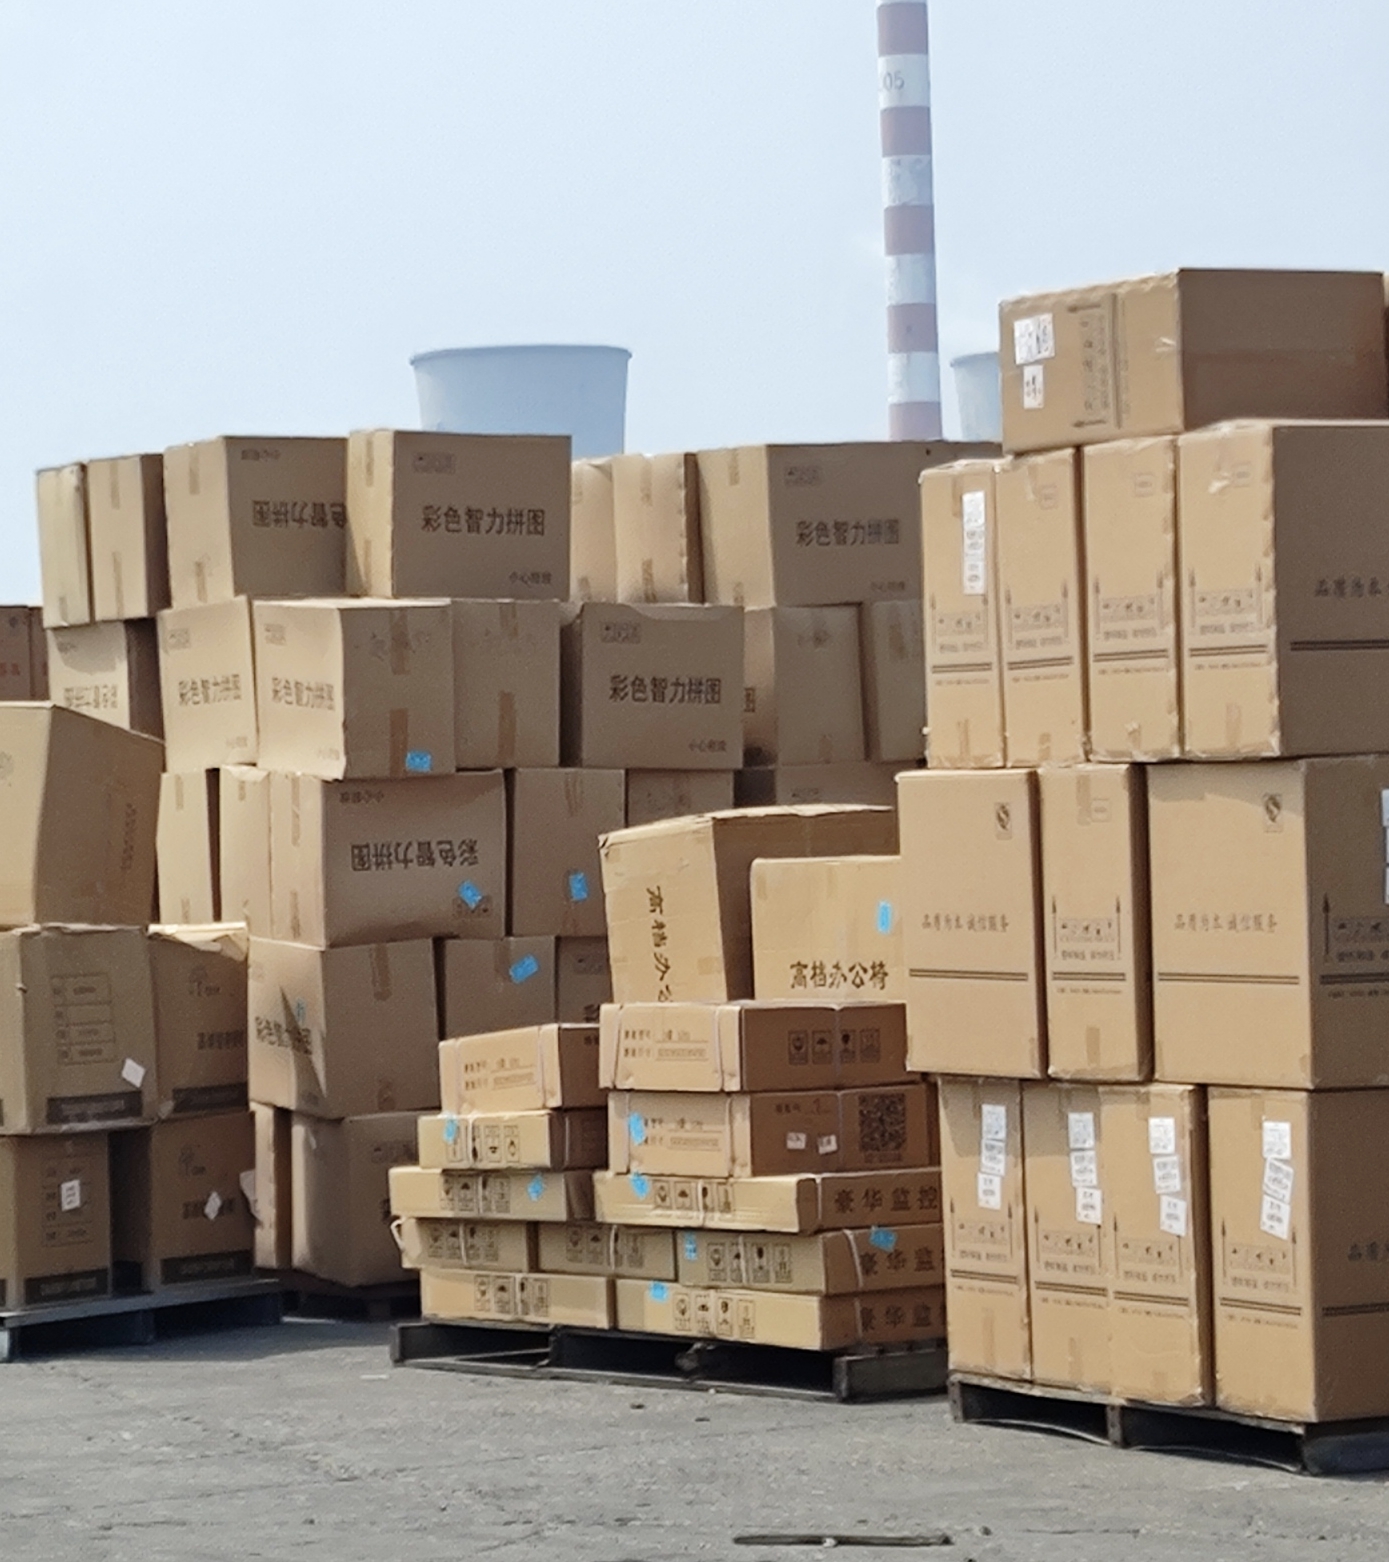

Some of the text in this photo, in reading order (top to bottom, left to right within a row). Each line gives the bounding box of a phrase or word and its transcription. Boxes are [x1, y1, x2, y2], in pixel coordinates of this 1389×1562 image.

[421, 504, 546, 536] 彩色智力拼图
[796, 520, 899, 547] 彩色智力拼图
[610, 675, 722, 704] 彩色智力拼图
[351, 839, 479, 871] 彩色智力拼图
[790, 961, 889, 990] 高档办公椅
[834, 1185, 938, 1214] 豪华监控
[860, 1246, 945, 1276] 豪华监
